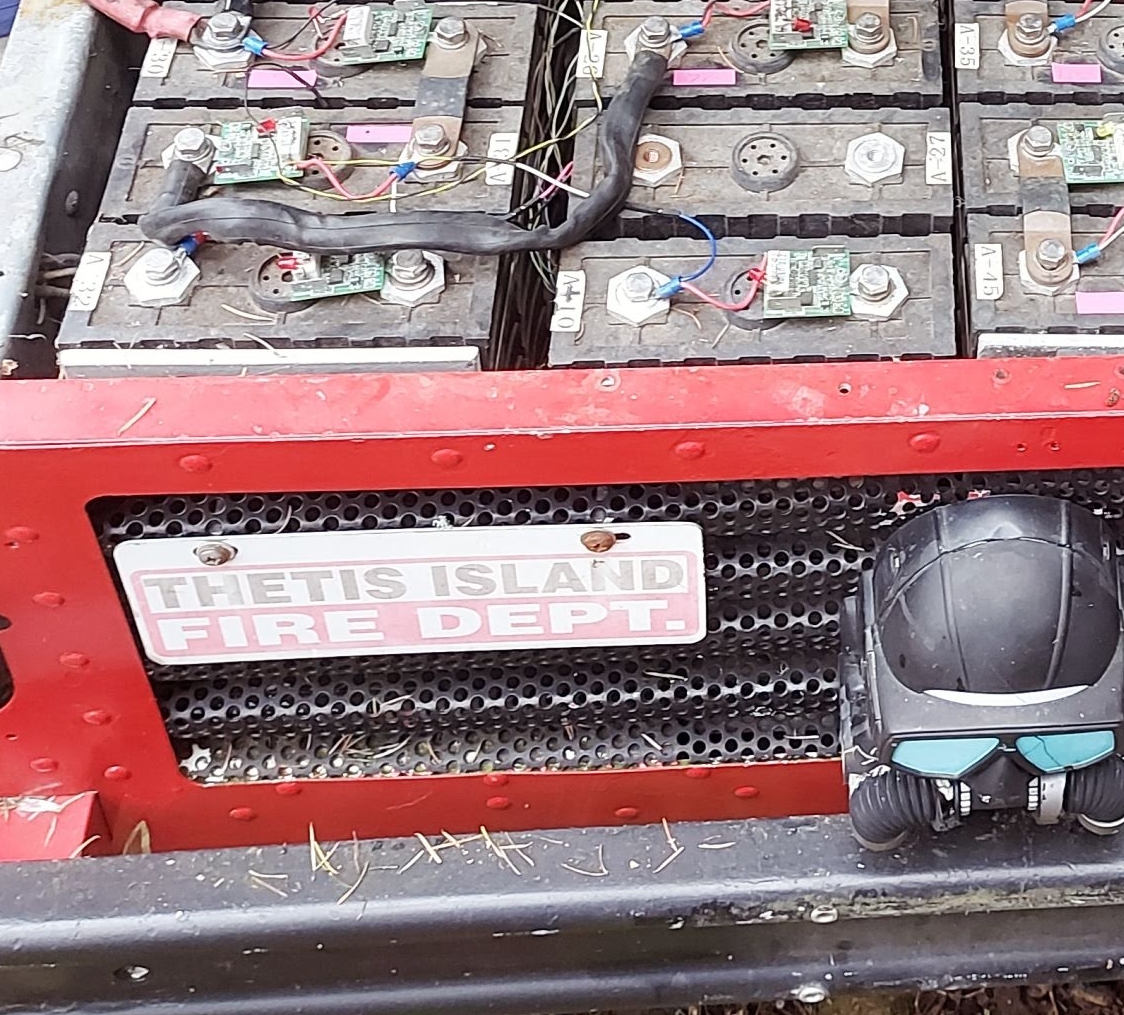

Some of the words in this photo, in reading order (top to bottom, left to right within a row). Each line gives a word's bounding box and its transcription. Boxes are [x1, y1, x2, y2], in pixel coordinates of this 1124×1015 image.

[143, 567, 407, 609] THETIS
[431, 559, 684, 597] ISLAND
[157, 609, 385, 651] FIRE
[416, 600, 686, 639] DEPT.
